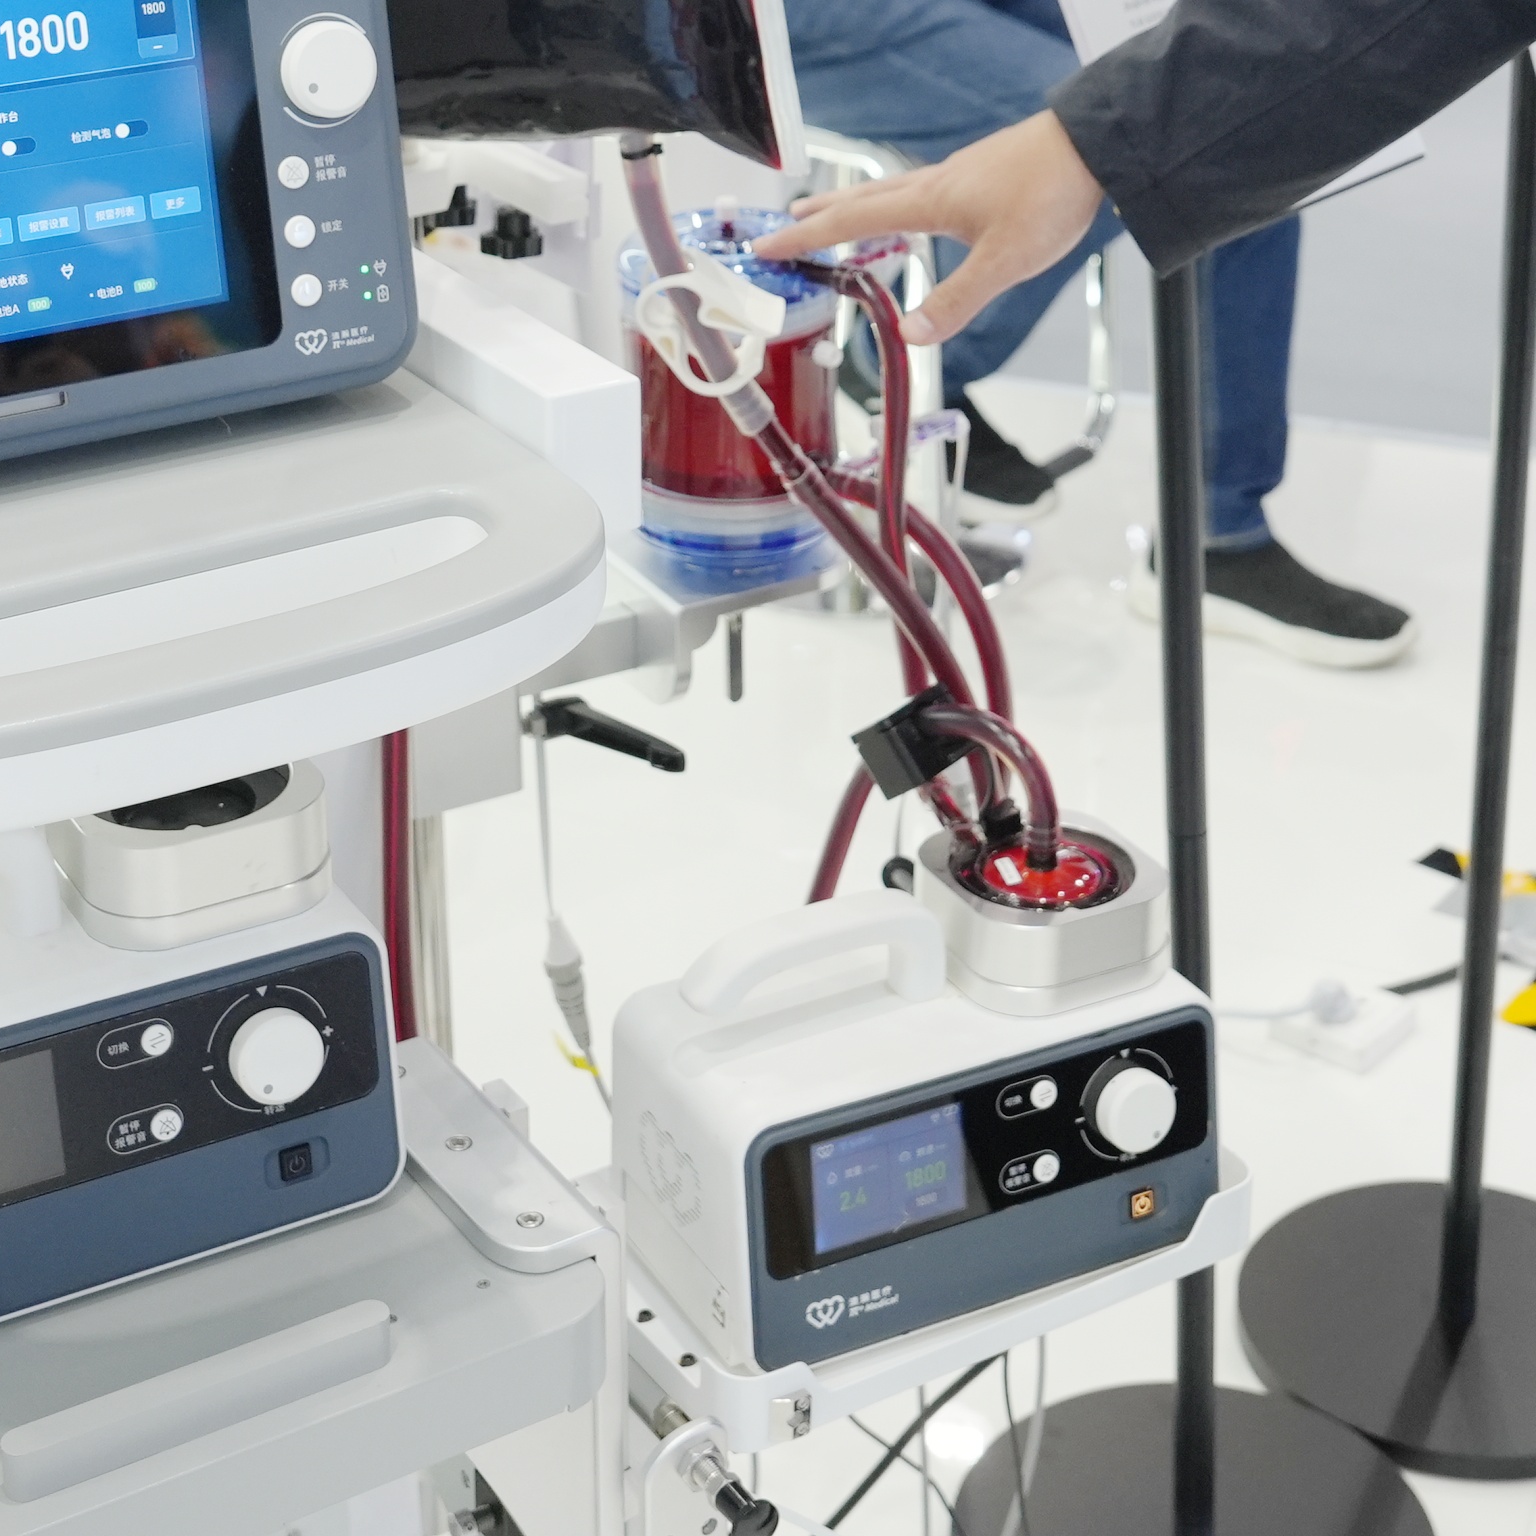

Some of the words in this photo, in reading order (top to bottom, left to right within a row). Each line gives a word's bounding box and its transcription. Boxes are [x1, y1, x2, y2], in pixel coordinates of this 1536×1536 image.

[142, 1, 165, 15] 1800
[0, 10, 89, 60] 1800
[71, 128, 111, 144] 检测气泡
[315, 154, 336, 167] 暂停
[316, 166, 347, 182] 报警音
[166, 197, 185, 211] 更多
[95, 205, 135, 222] 报警列表
[29, 217, 69, 233] 报警设置
[321, 220, 342, 233] 锁定
[97, 285, 123, 299] 电池B
[137, 280, 152, 290] 100
[328, 279, 349, 291] 开关
[31, 299, 47, 310] 100
[347, 335, 375, 347] Medical
[107, 1040, 130, 1057] 切换
[118, 1120, 141, 1135] 暂停
[114, 1130, 147, 1149] 报警音
